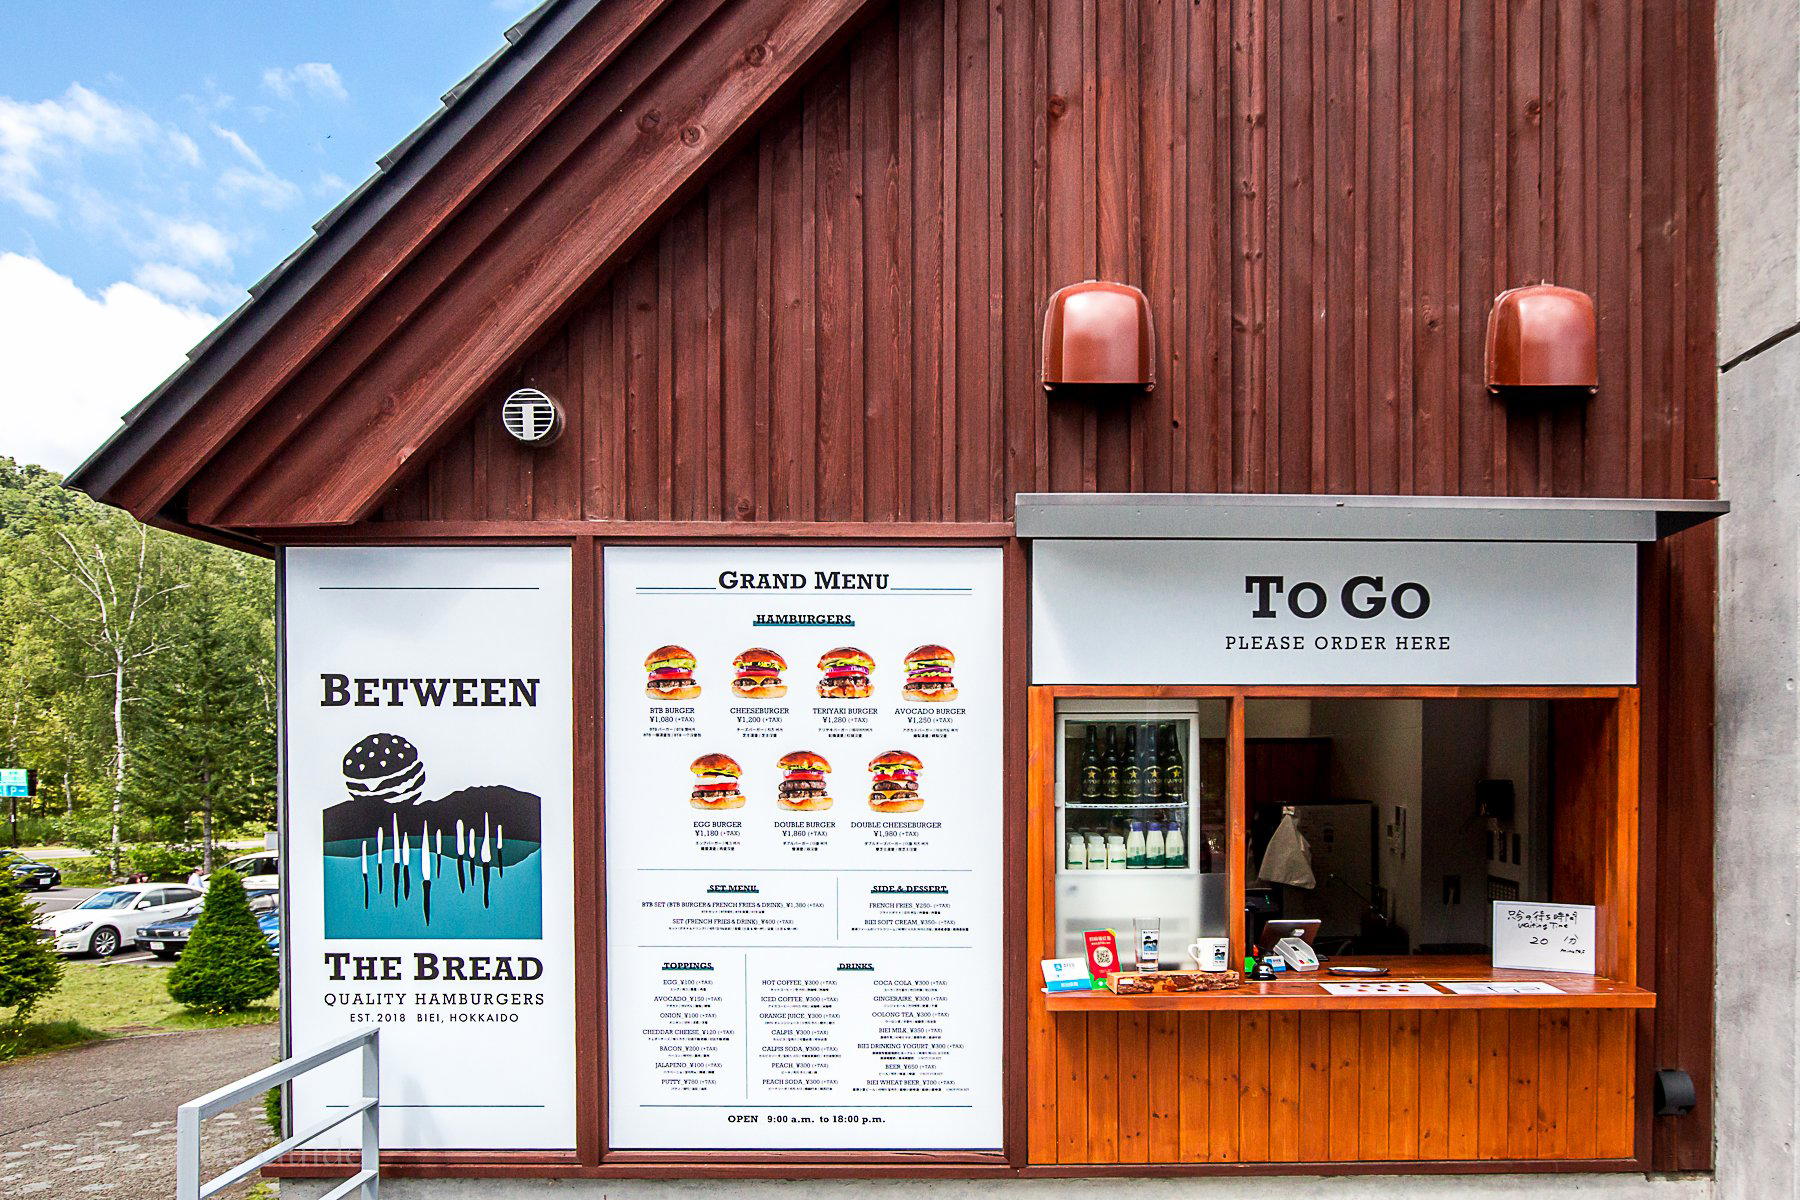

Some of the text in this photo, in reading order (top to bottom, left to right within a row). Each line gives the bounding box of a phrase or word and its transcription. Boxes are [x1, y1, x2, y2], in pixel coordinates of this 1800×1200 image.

[719, 571, 890, 590] GRAND MENU
[756, 615, 852, 625] HAMBURGERS
[1225, 636, 1450, 650] PLEASE ORDER HERE
[320, 673, 540, 707] BETWEEN
[324, 953, 543, 981] THE BREAD
[324, 993, 544, 1006] QUALITY HAMBURGERS
[417, 1014, 444, 1023] BIEI,
[450, 1014, 518, 1022] HOKKAIDO
[728, 1115, 885, 1125] OPEN 9:00 a.m. to 18:00 p.m.
